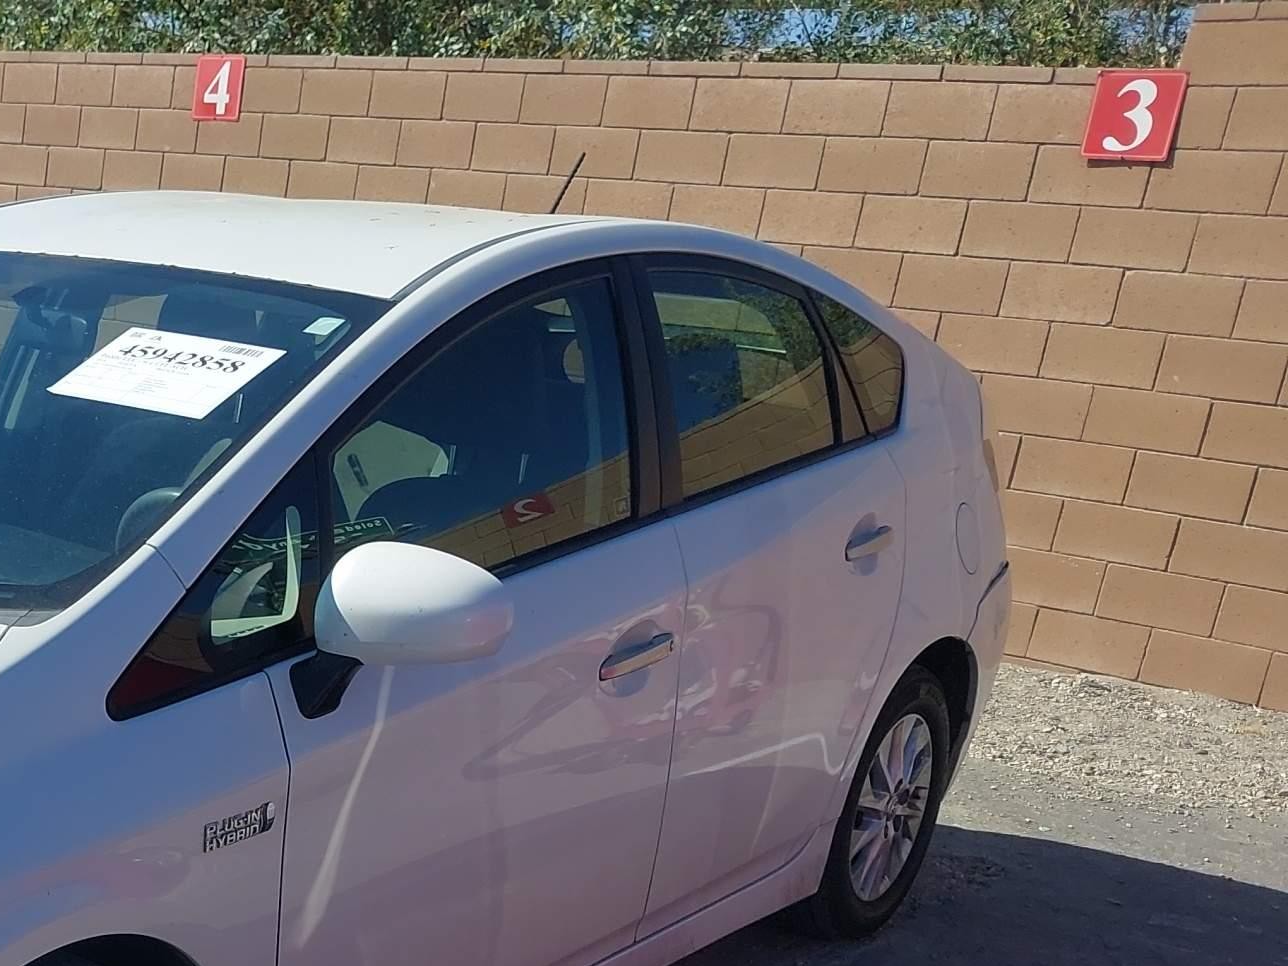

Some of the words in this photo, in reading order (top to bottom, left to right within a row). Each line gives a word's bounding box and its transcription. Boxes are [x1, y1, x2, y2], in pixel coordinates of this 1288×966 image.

[203, 60, 231, 115] 4
[1102, 78, 1158, 152] 3
[118, 344, 247, 374] 45942858
[206, 808, 261, 838] PLUG-IN
[206, 824, 260, 853] HYBRID
